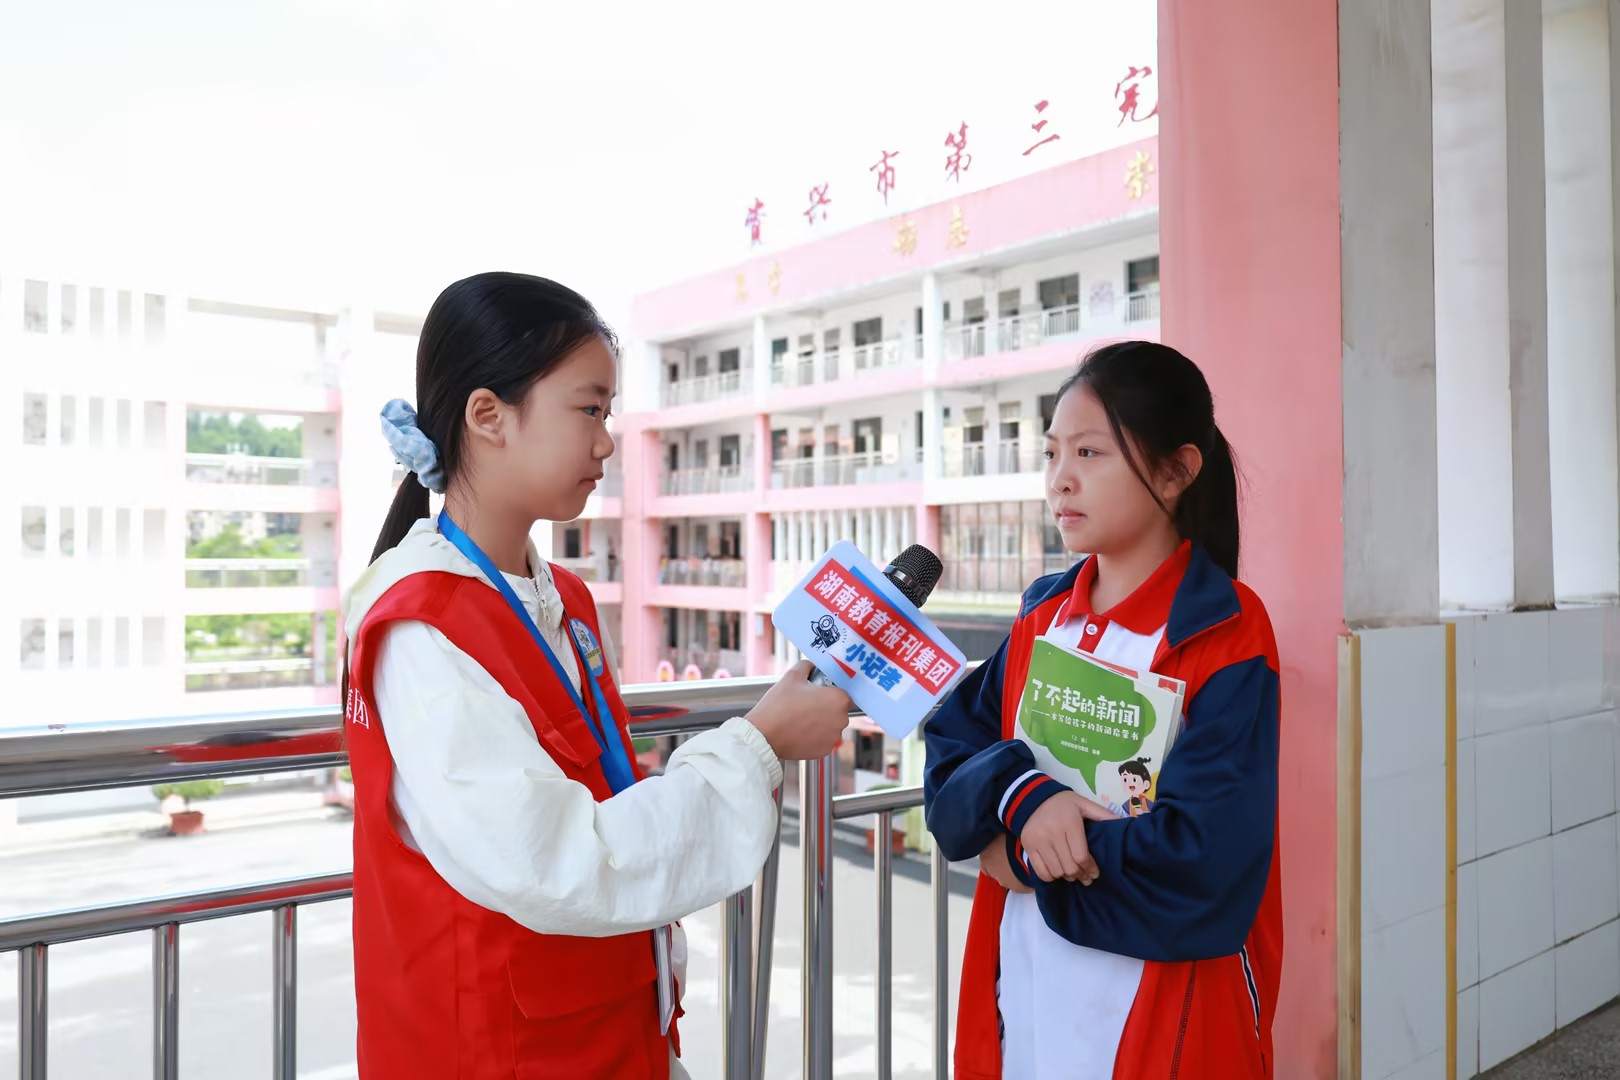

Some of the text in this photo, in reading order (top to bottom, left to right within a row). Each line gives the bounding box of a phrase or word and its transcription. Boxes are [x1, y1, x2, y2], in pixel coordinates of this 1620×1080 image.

[814, 569, 954, 688] 湖南教育报刊集团
[845, 642, 903, 692] 小记者
[1031, 678, 1140, 728] 了不起的新闻
